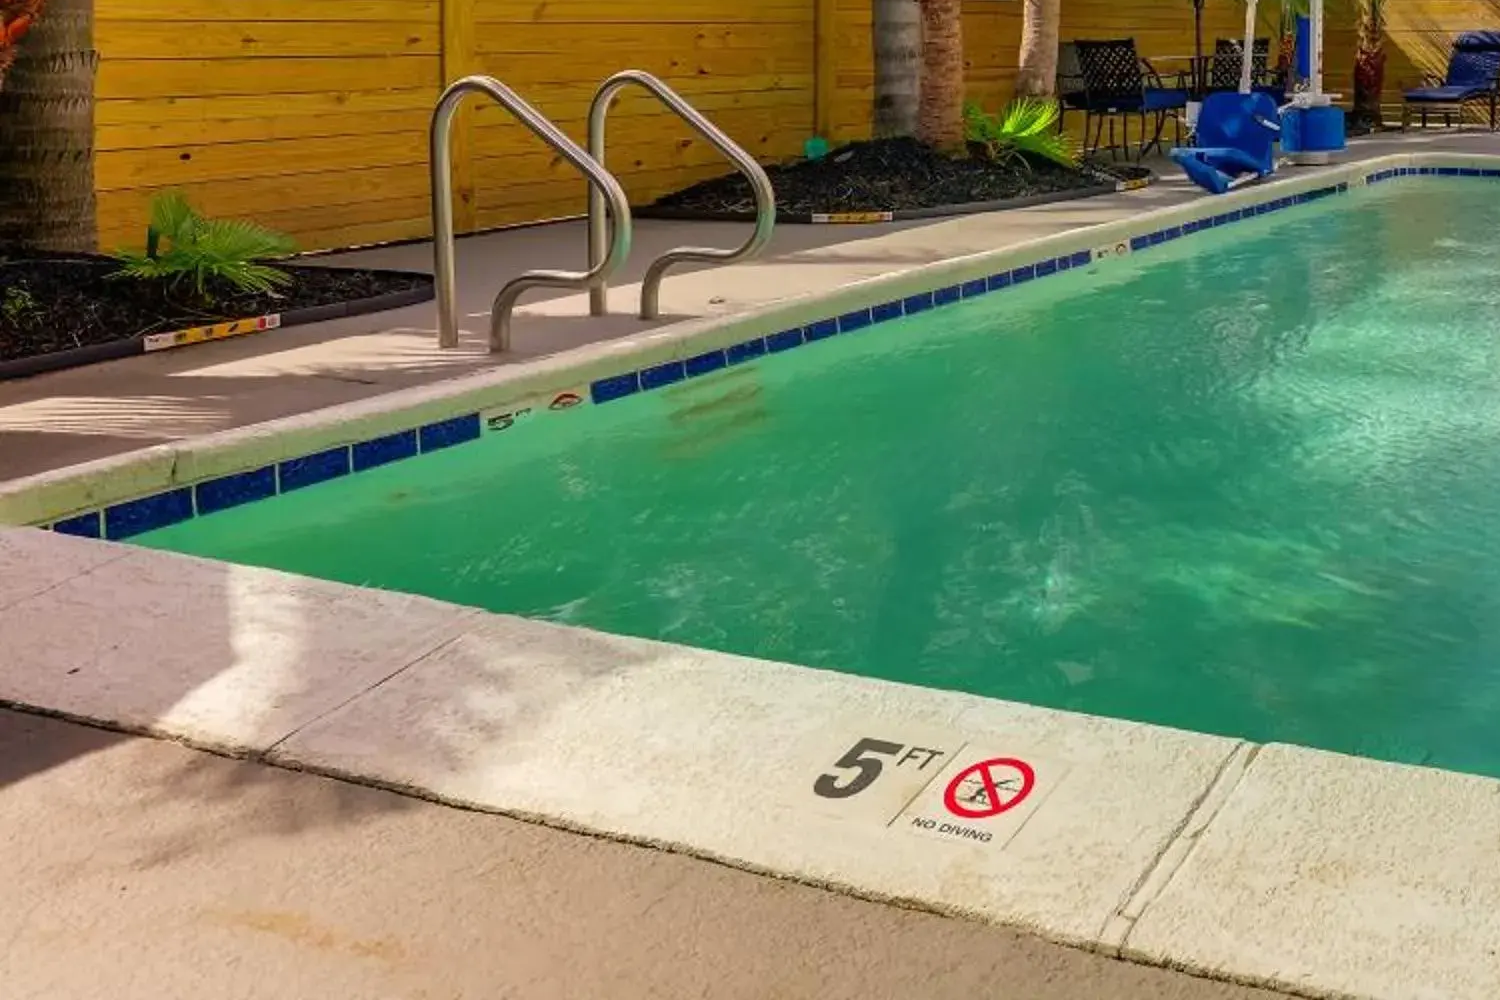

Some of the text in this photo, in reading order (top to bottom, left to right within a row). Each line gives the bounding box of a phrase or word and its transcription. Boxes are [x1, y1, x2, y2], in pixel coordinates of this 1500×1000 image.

[813, 737, 945, 799] 5 FT
[911, 817, 994, 843] NO DIVING
